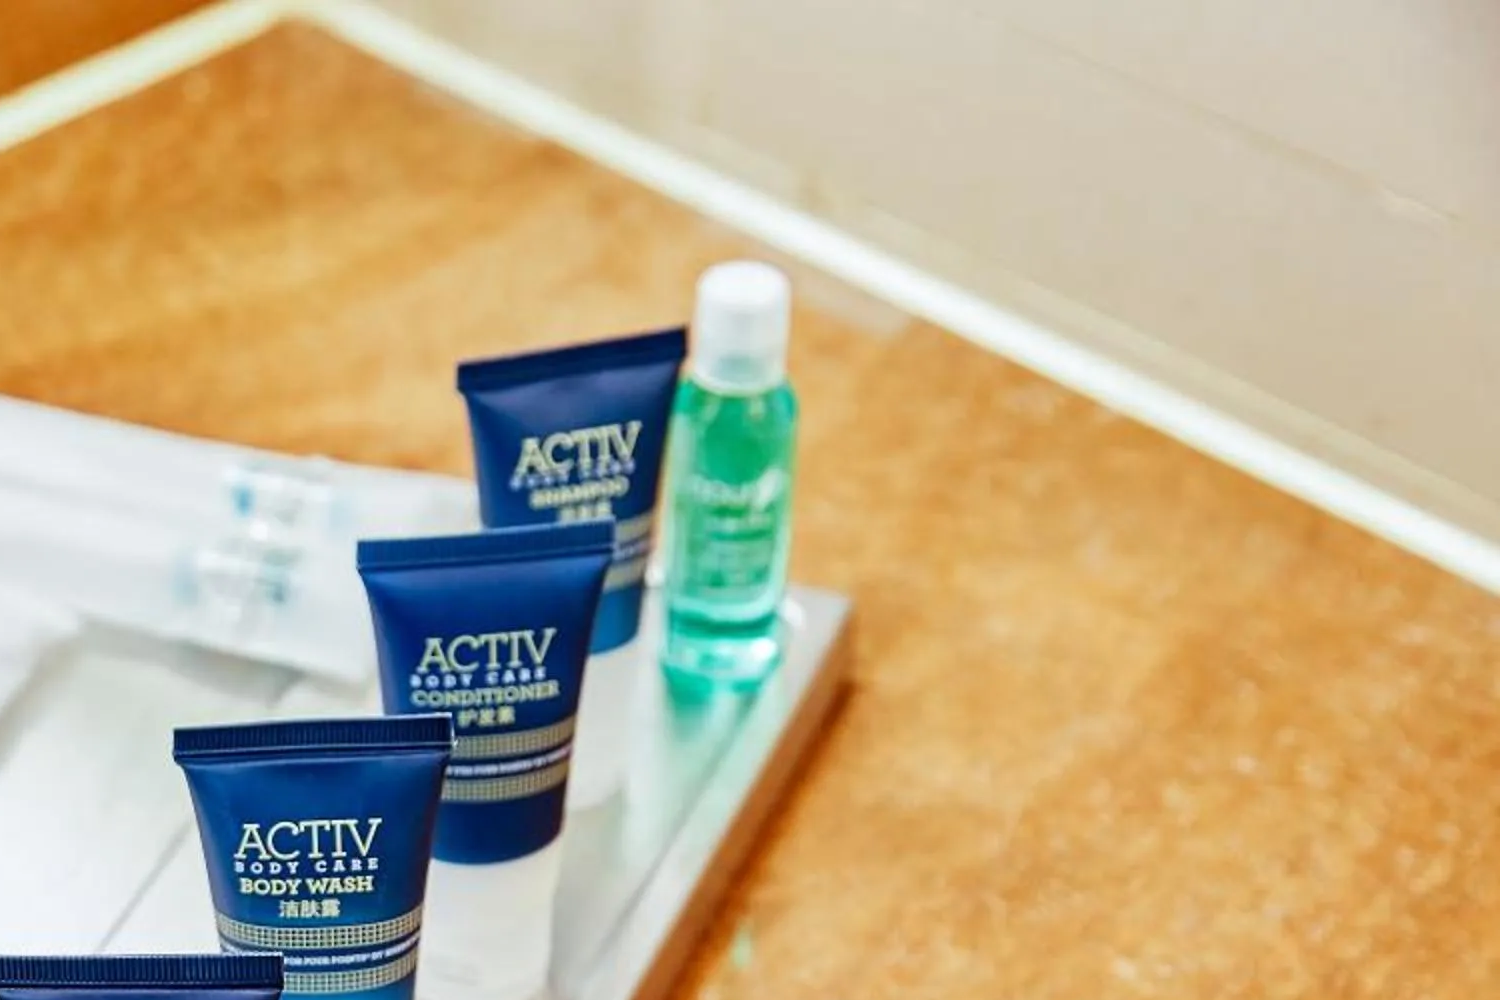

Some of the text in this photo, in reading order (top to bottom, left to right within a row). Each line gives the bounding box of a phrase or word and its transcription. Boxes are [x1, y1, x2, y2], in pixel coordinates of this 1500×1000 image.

[510, 420, 643, 483] ACTIV
[529, 475, 630, 510] SHAMPOO
[416, 627, 558, 674] ACTIV
[409, 673, 473, 689] BODY
[410, 679, 560, 708] CONDITIONER
[233, 817, 383, 861] ACTIV
[234, 857, 380, 875] BODY CARE
[239, 875, 374, 896] BODY WASH
